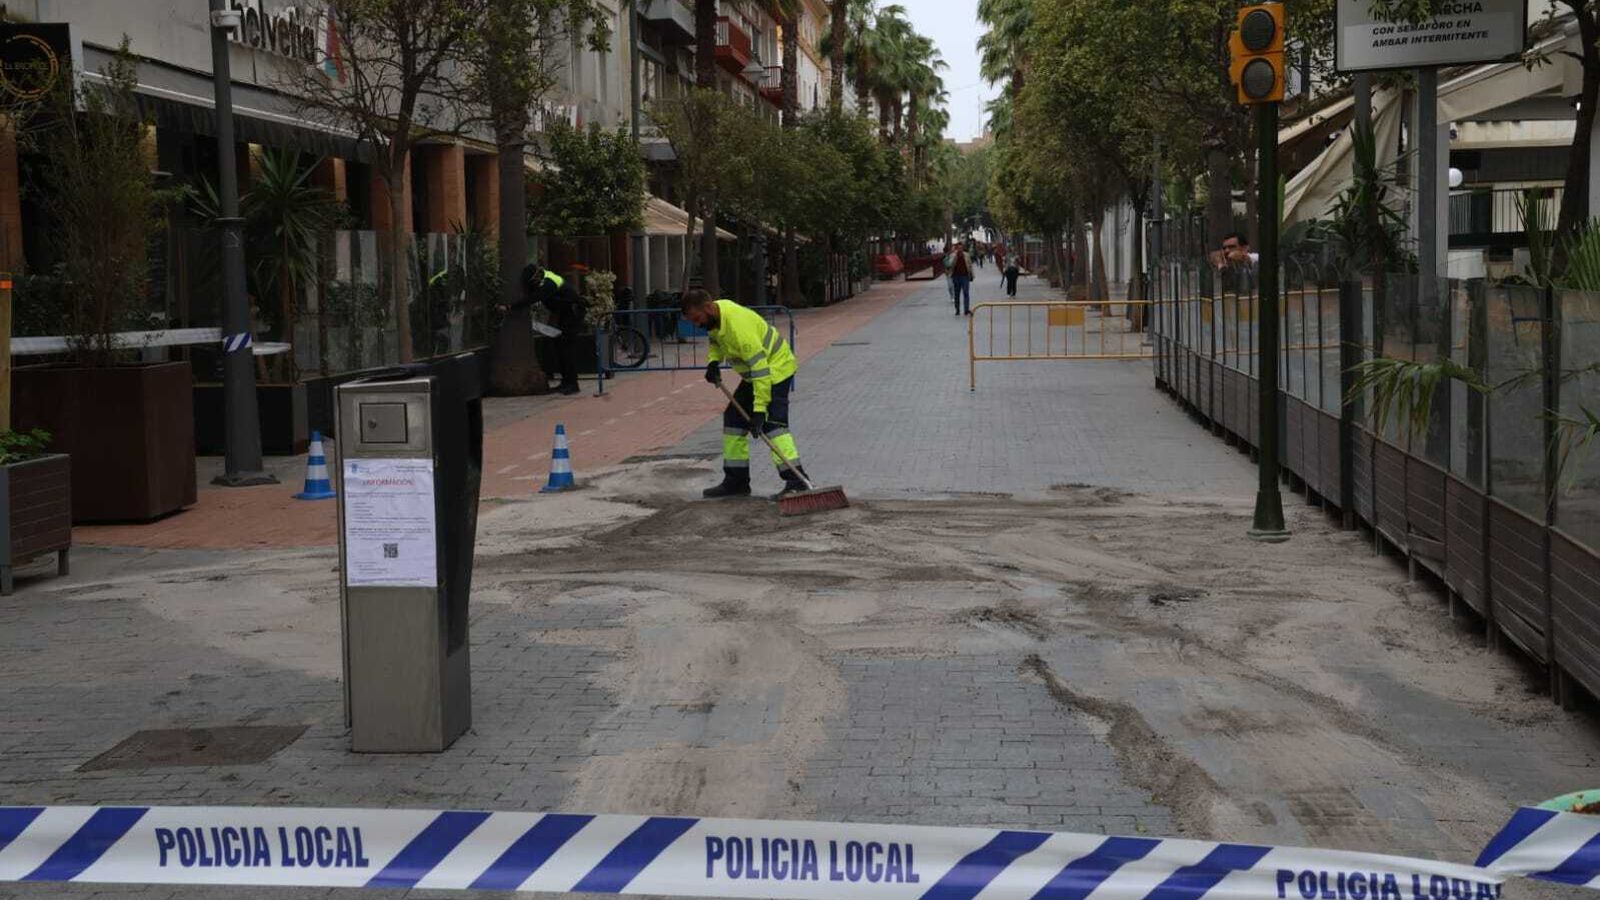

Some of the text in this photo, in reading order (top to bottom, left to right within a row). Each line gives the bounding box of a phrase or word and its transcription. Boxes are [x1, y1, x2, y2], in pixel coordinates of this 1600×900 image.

[1372, 26, 1395, 36] CON
[1456, 18, 1472, 28] EN
[1372, 29, 1490, 48] AMBAR INTERMITENTE
[155, 826, 369, 869] POLICIA LOCAL
[705, 836, 920, 884] POLICIA LOCAL
